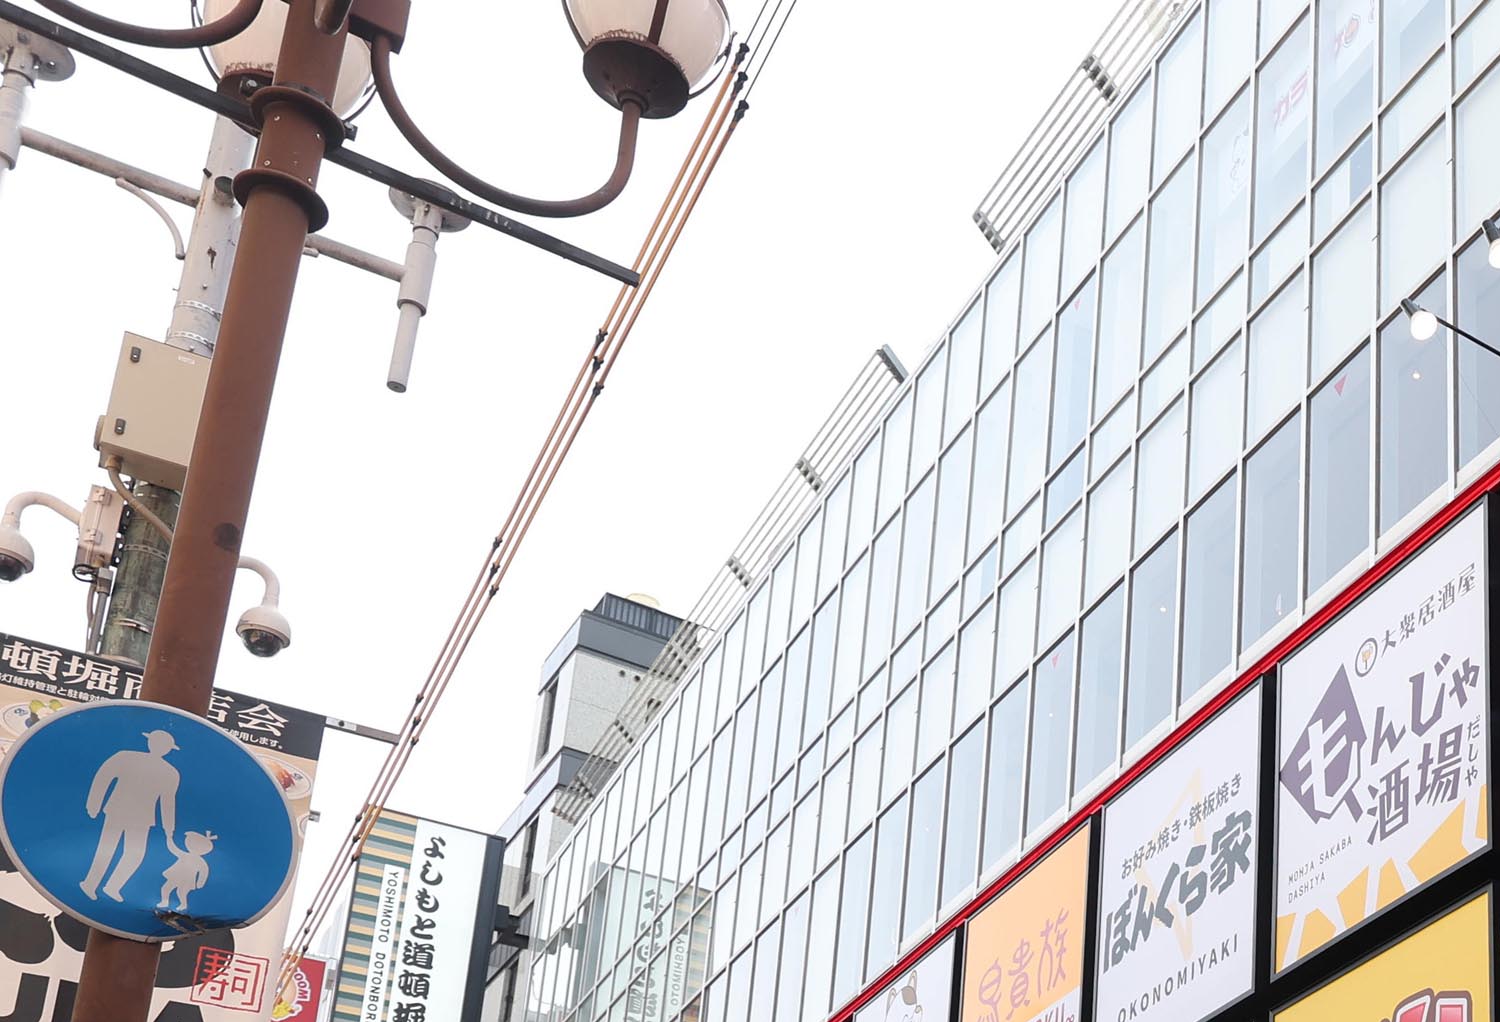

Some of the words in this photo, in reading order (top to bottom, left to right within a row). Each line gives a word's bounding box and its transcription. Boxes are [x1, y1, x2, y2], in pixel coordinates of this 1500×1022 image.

[1380, 562, 1477, 659] 大衆居酒屋
[1367, 723, 1464, 846] 酒場
[1464, 714, 1481, 788] だしや
[1121, 773, 1242, 880] お好み焼き・鉄板焼き
[1288, 860, 1317, 888] MONJA
[1319, 836, 1354, 866] SAKABA
[378, 871, 399, 944] YOSHIMOTO
[1103, 809, 1252, 974] ぼんくら家
[1288, 872, 1327, 904] DASHIYA
